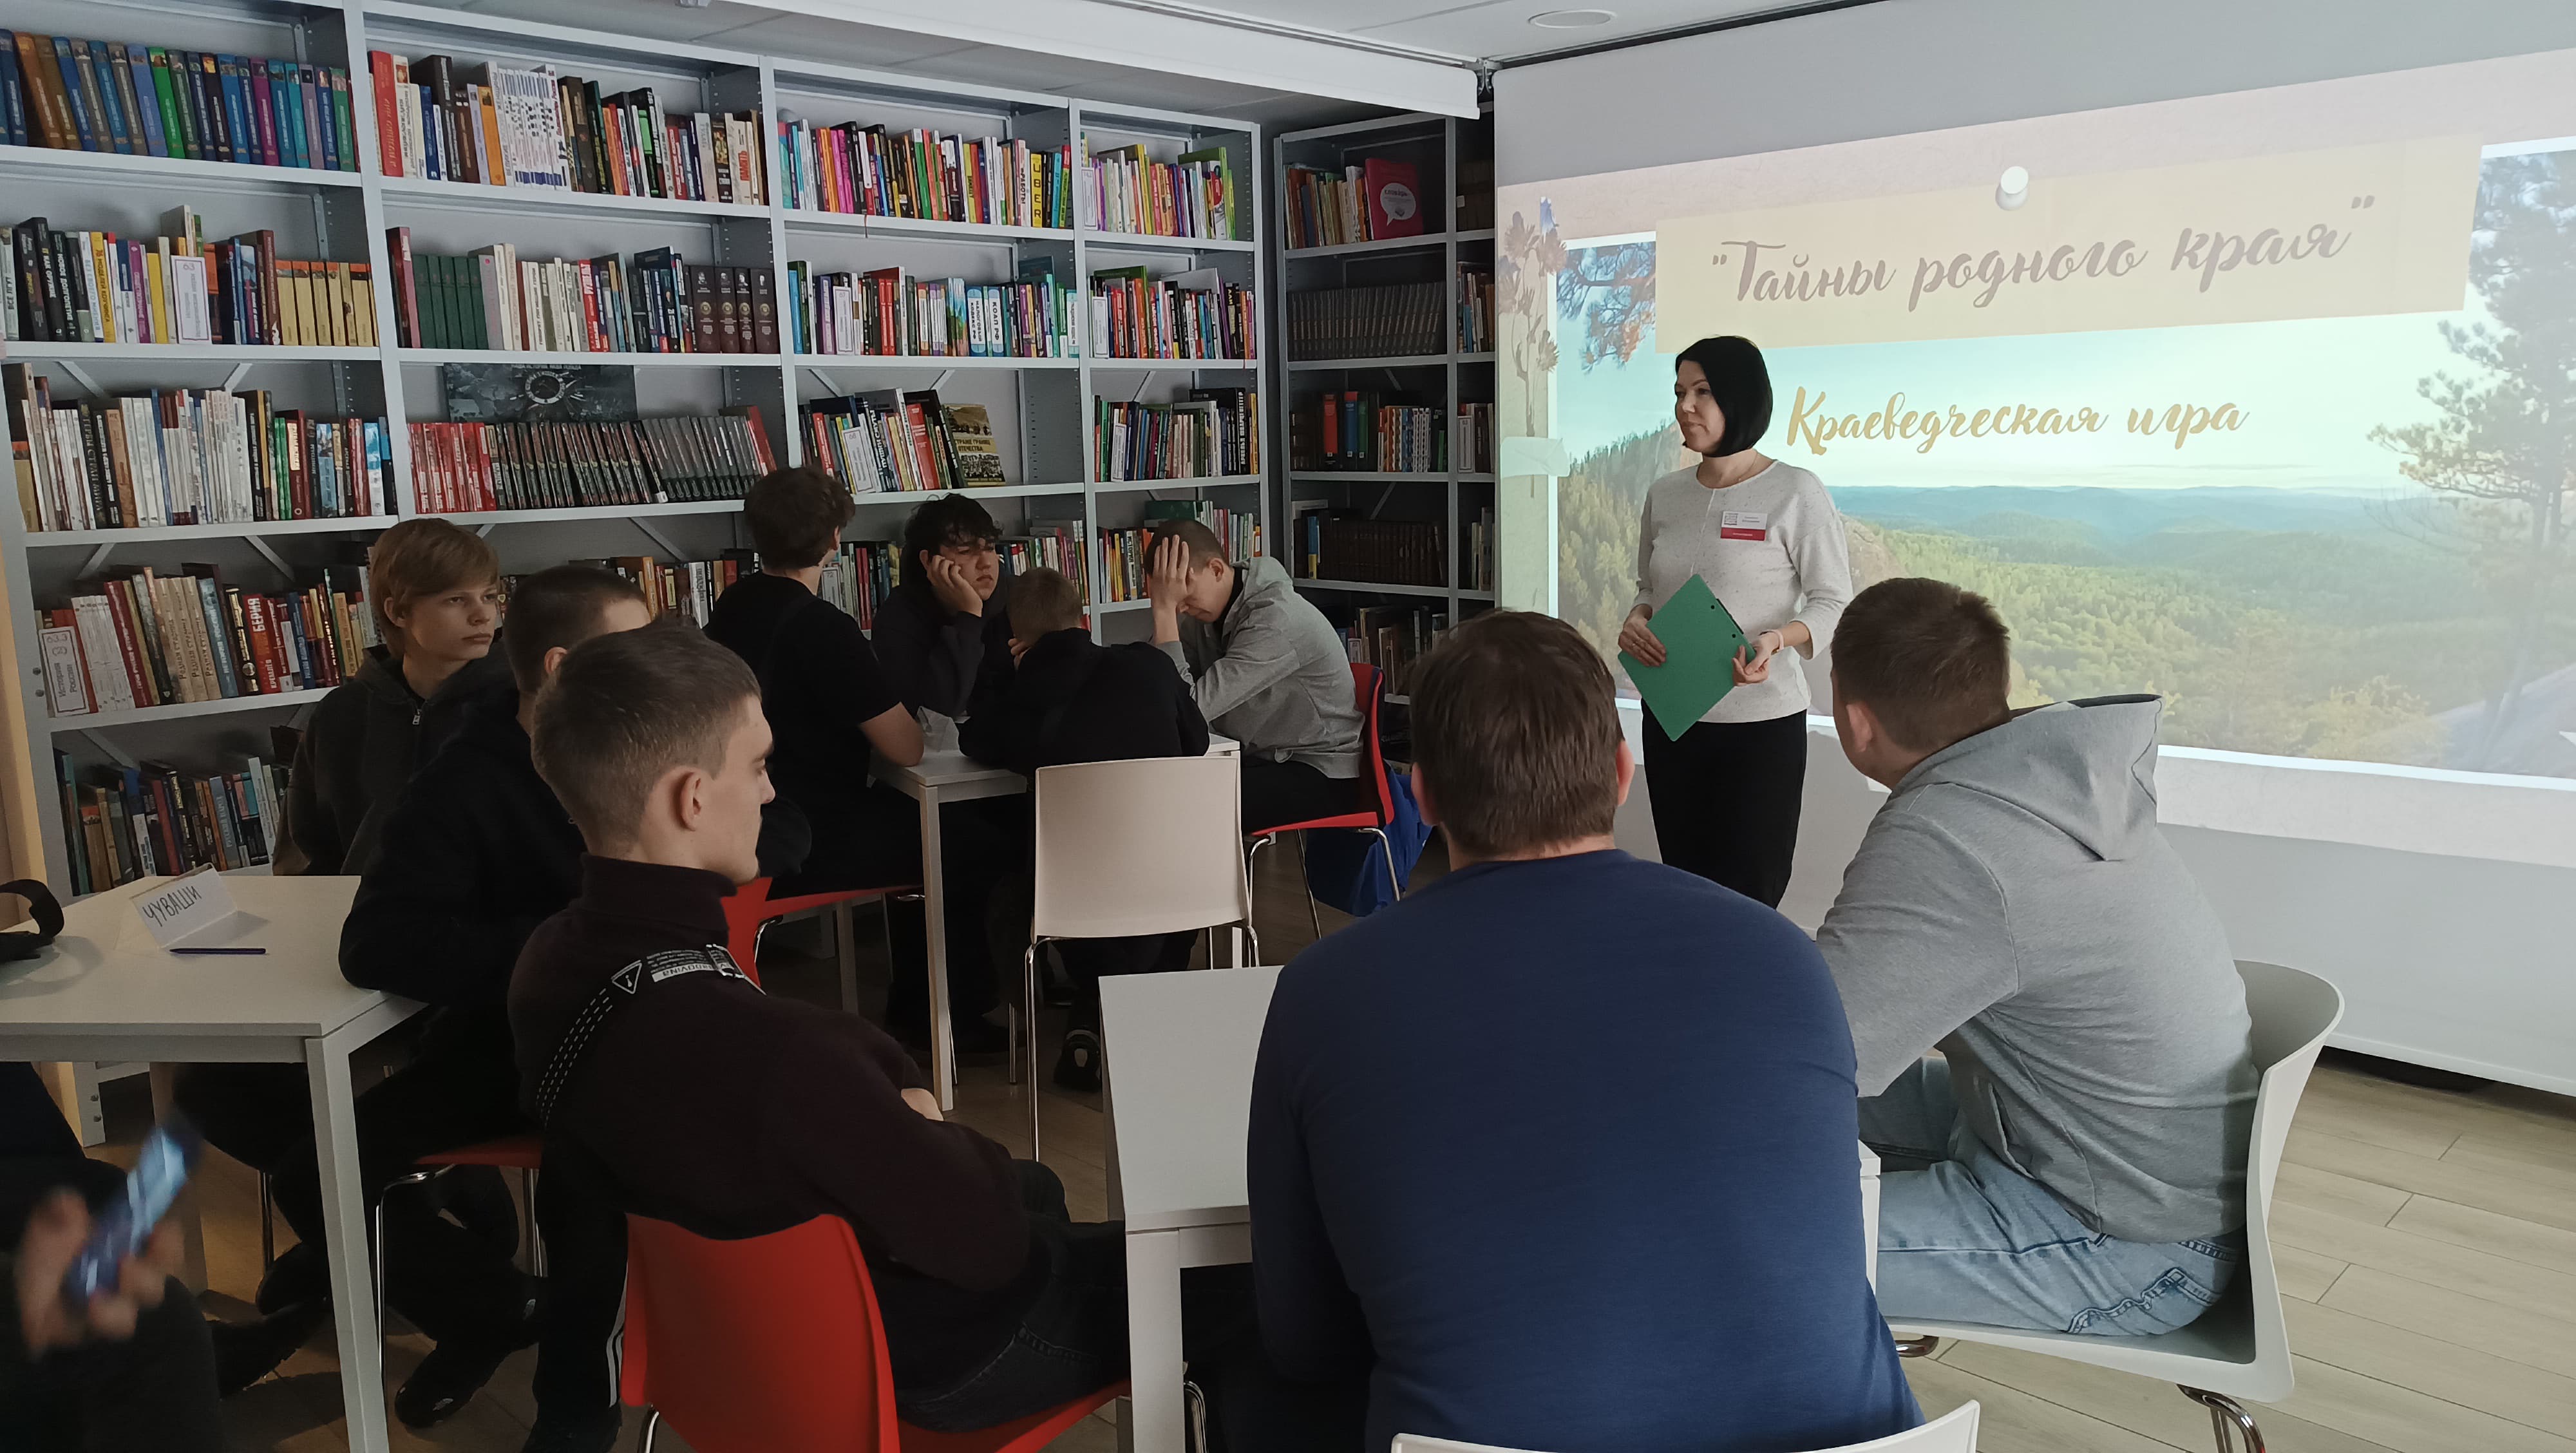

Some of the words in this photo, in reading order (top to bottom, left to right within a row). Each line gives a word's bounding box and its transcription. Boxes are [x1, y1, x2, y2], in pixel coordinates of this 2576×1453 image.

[43, 256, 52, 269] КАК
[1710, 239, 1897, 302] "Тайны
[1908, 240, 2147, 312] родного
[2170, 195, 2376, 292] края"
[45, 271, 56, 298] ОРУЖИЕ
[97, 258, 106, 289] МОДЕЛЕЙ
[60, 278, 72, 320] ДОЛГОЛЕТИЕ
[100, 290, 110, 322] КОУЧИНГА
[994, 328, 999, 340] РФ
[82, 418, 95, 446] ГЕРБЫ
[870, 410, 880, 437] СМУТЫ
[1785, 386, 2108, 456] Краеведческая
[2128, 399, 2251, 455] игра
[87, 449, 99, 481] СТРАН
[91, 484, 102, 511] МИРА
[247, 598, 266, 632] БЕРИЯ
[217, 641, 230, 674] ИСТОРИЯ
[53, 662, 66, 698] История
[265, 659, 278, 689] КРЕМЛЁВ
[142, 886, 202, 927] ЧУВАШИ
